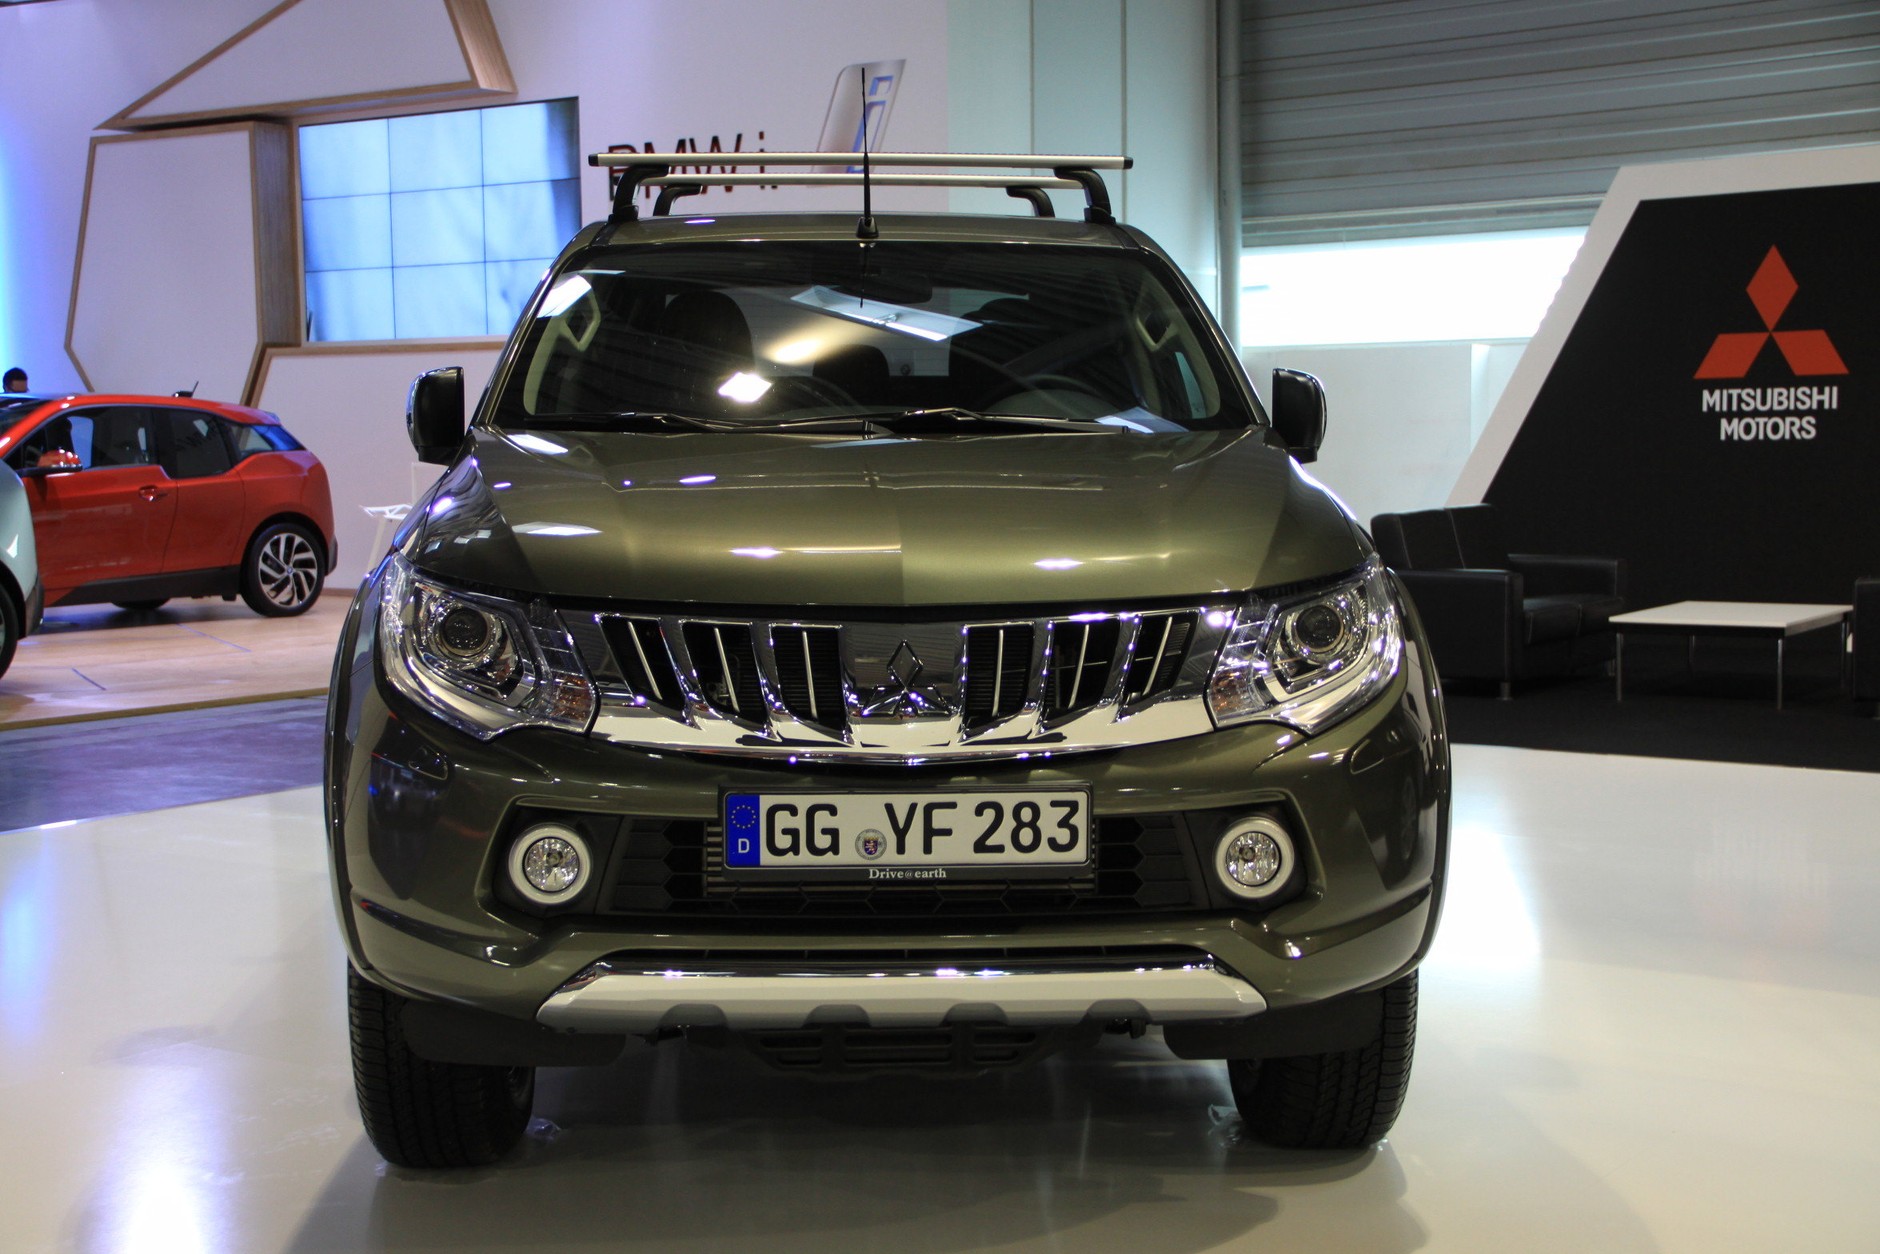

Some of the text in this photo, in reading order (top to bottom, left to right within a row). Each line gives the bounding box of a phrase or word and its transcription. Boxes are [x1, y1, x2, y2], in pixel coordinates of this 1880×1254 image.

[1702, 386, 1838, 412] MITSUBISHI
[1720, 416, 1817, 441] MOTORS
[766, 803, 840, 857] GG
[884, 801, 958, 855] YF
[973, 800, 1079, 854] 283
[738, 838, 750, 853] D
